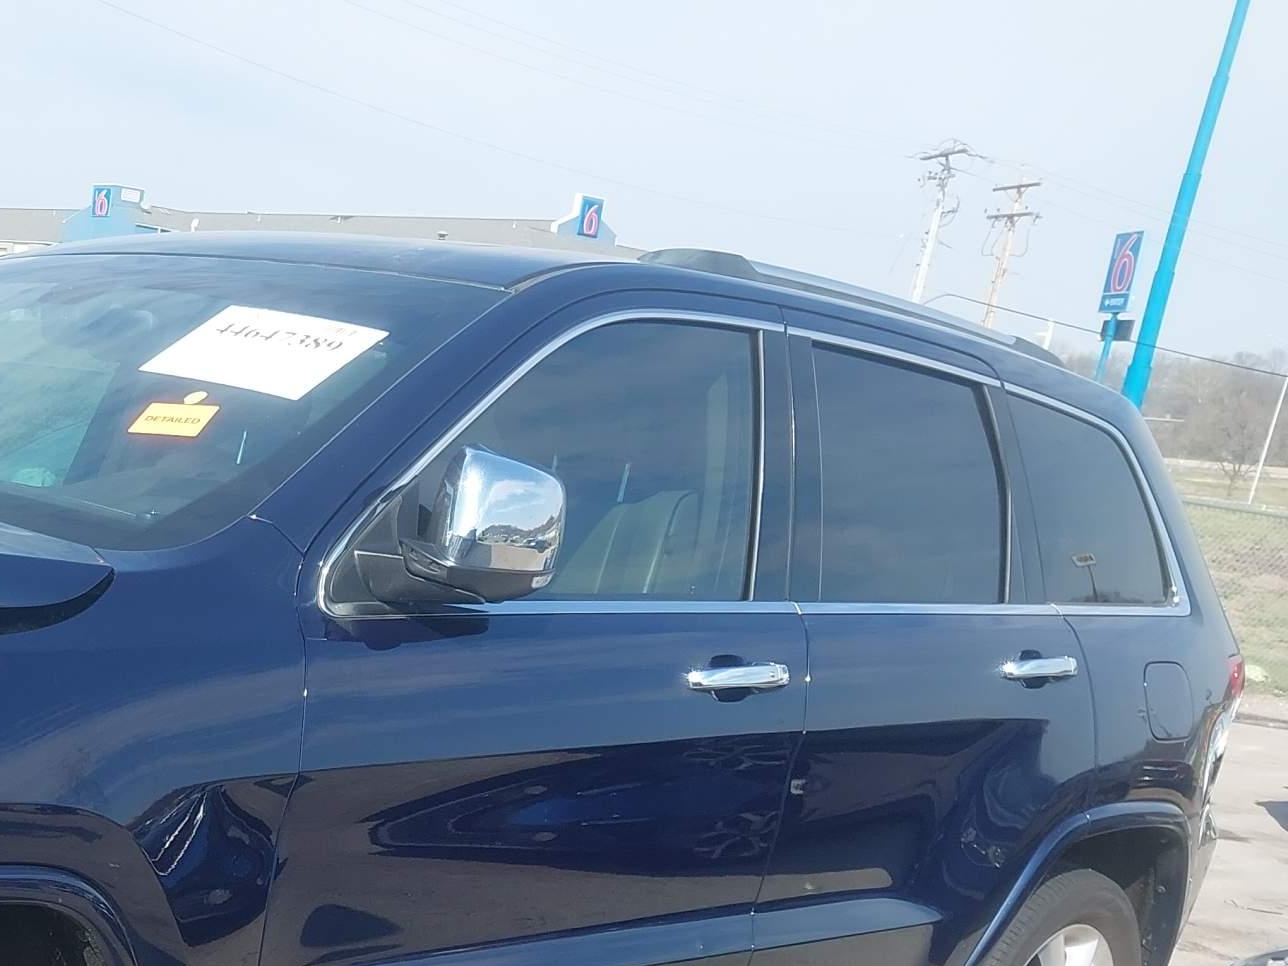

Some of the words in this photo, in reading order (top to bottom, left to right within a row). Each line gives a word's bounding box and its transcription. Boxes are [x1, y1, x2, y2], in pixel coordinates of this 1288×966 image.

[96, 189, 108, 216] 6
[584, 205, 599, 235] 6
[1113, 233, 1138, 292] 6
[144, 415, 201, 426] DETAILED
